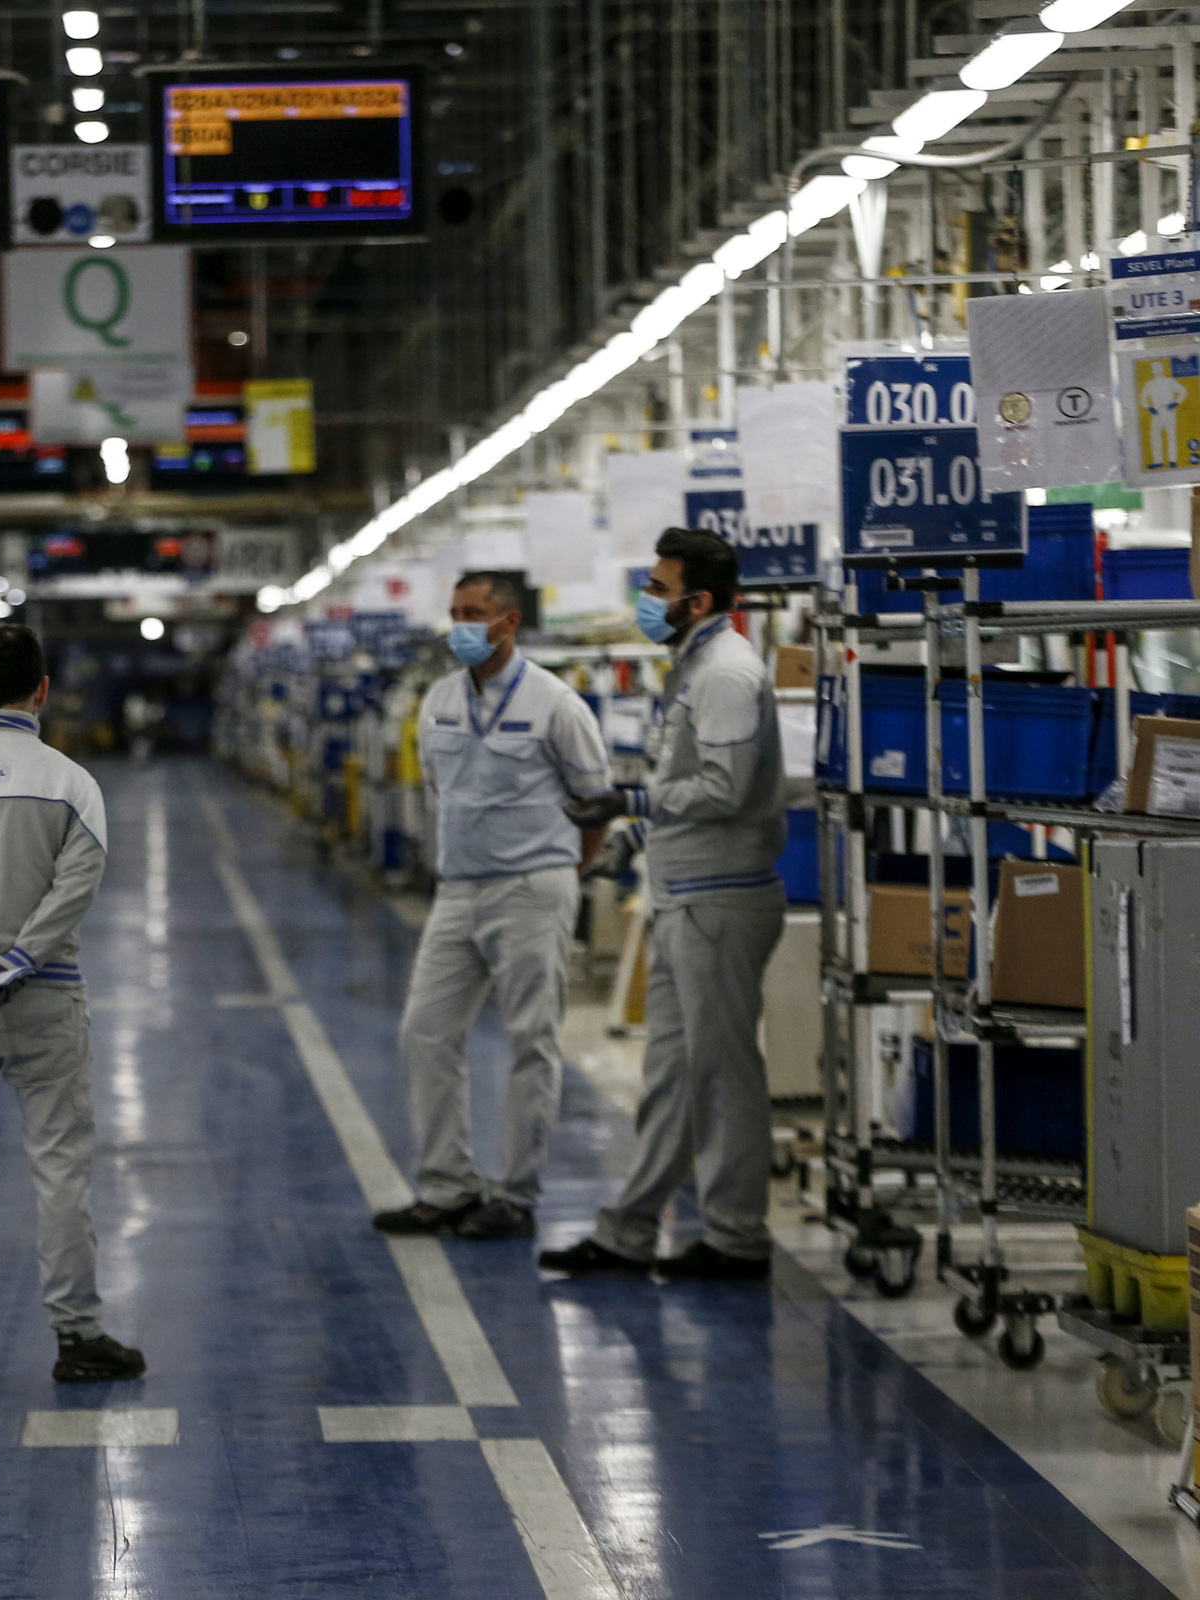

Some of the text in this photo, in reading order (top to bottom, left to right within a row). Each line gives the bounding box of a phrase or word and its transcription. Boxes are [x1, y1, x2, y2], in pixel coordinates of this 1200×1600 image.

[21, 151, 141, 178] CORSIE
[1128, 258, 1196, 273] SEVEL Plant
[62, 255, 131, 347] Q
[1131, 289, 1184, 309] UTE 3
